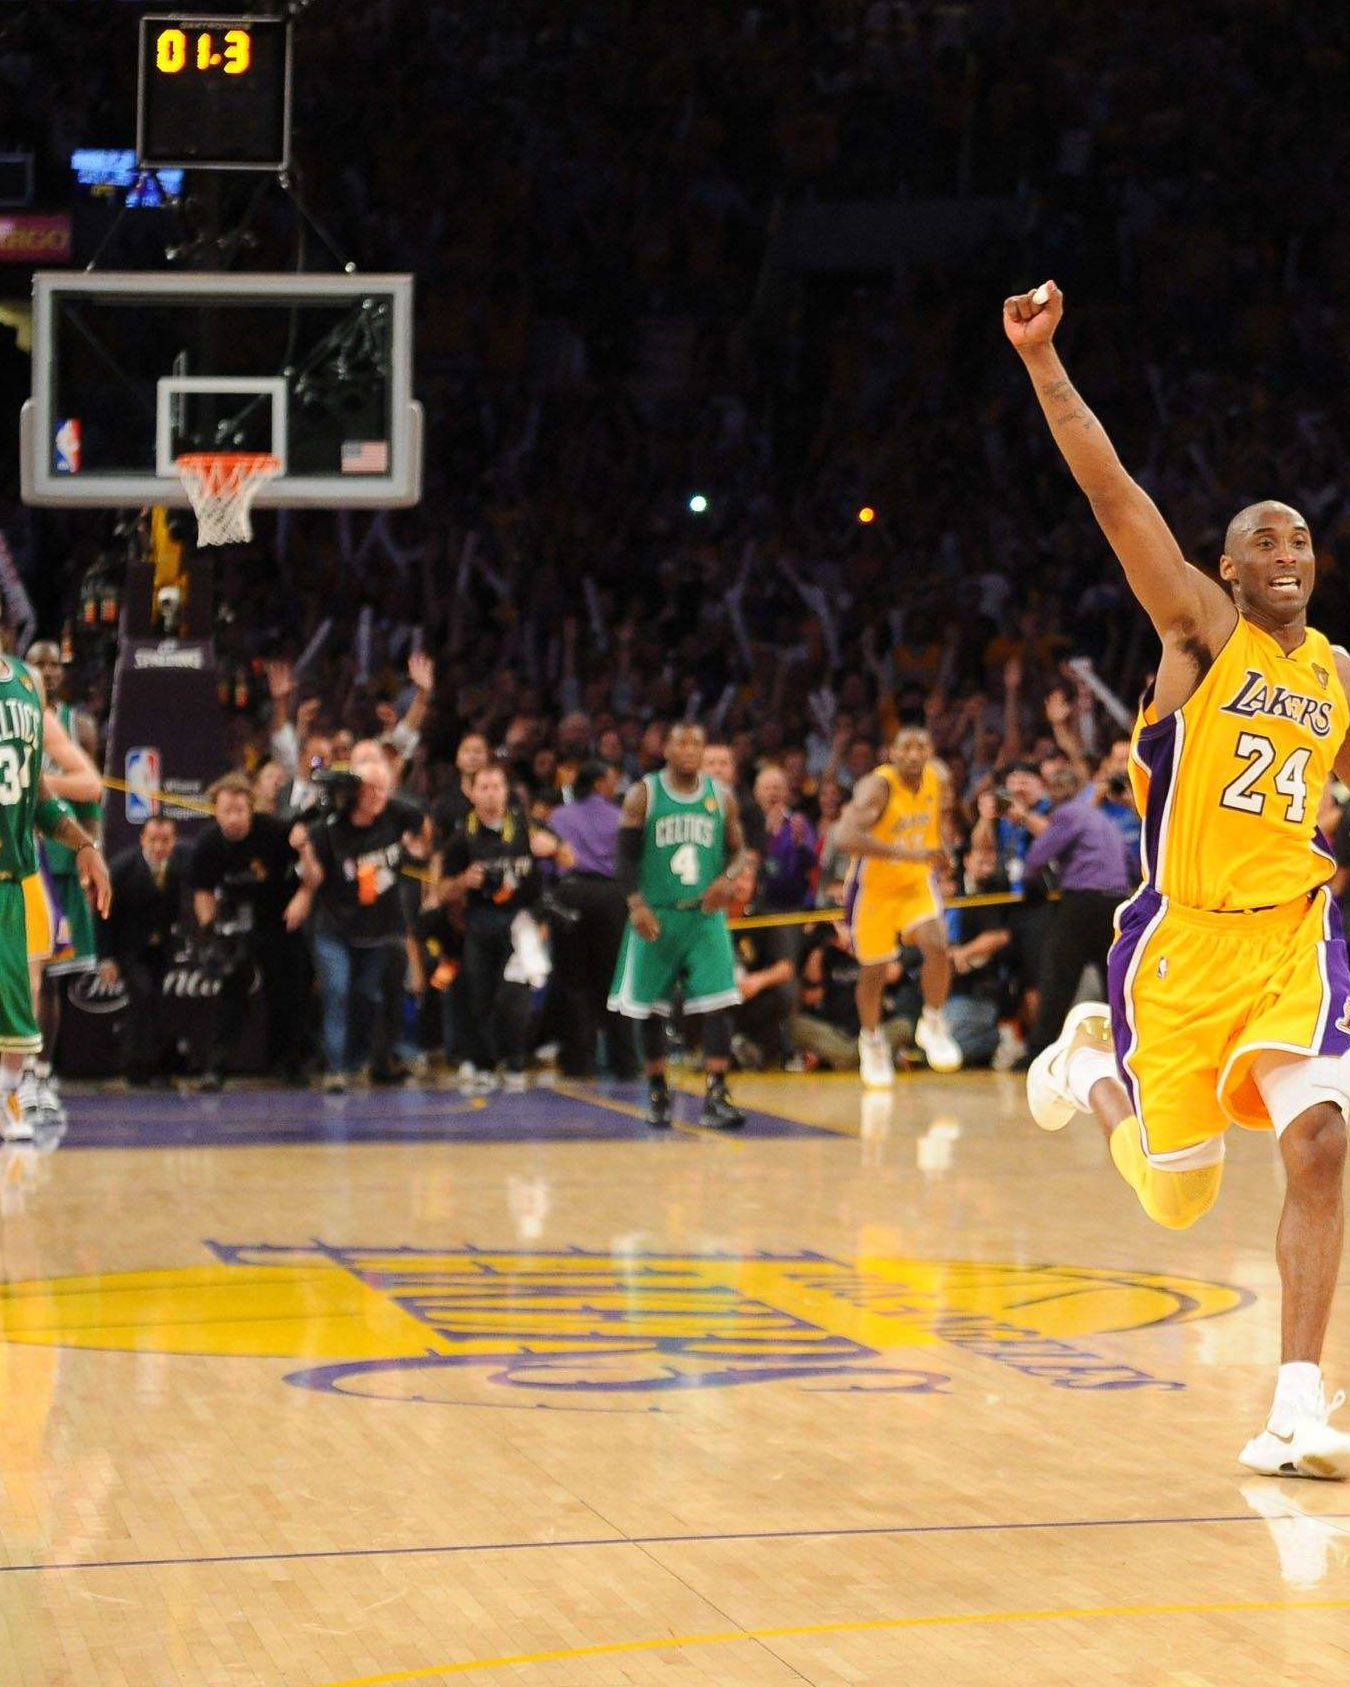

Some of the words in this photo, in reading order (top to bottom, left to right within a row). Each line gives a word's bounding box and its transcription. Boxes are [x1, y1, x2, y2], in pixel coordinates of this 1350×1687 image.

[1220, 671, 1332, 737] LAKERS
[1219, 731, 1313, 824] 24
[656, 813, 714, 849] CELTICS
[669, 844, 699, 886] 4
